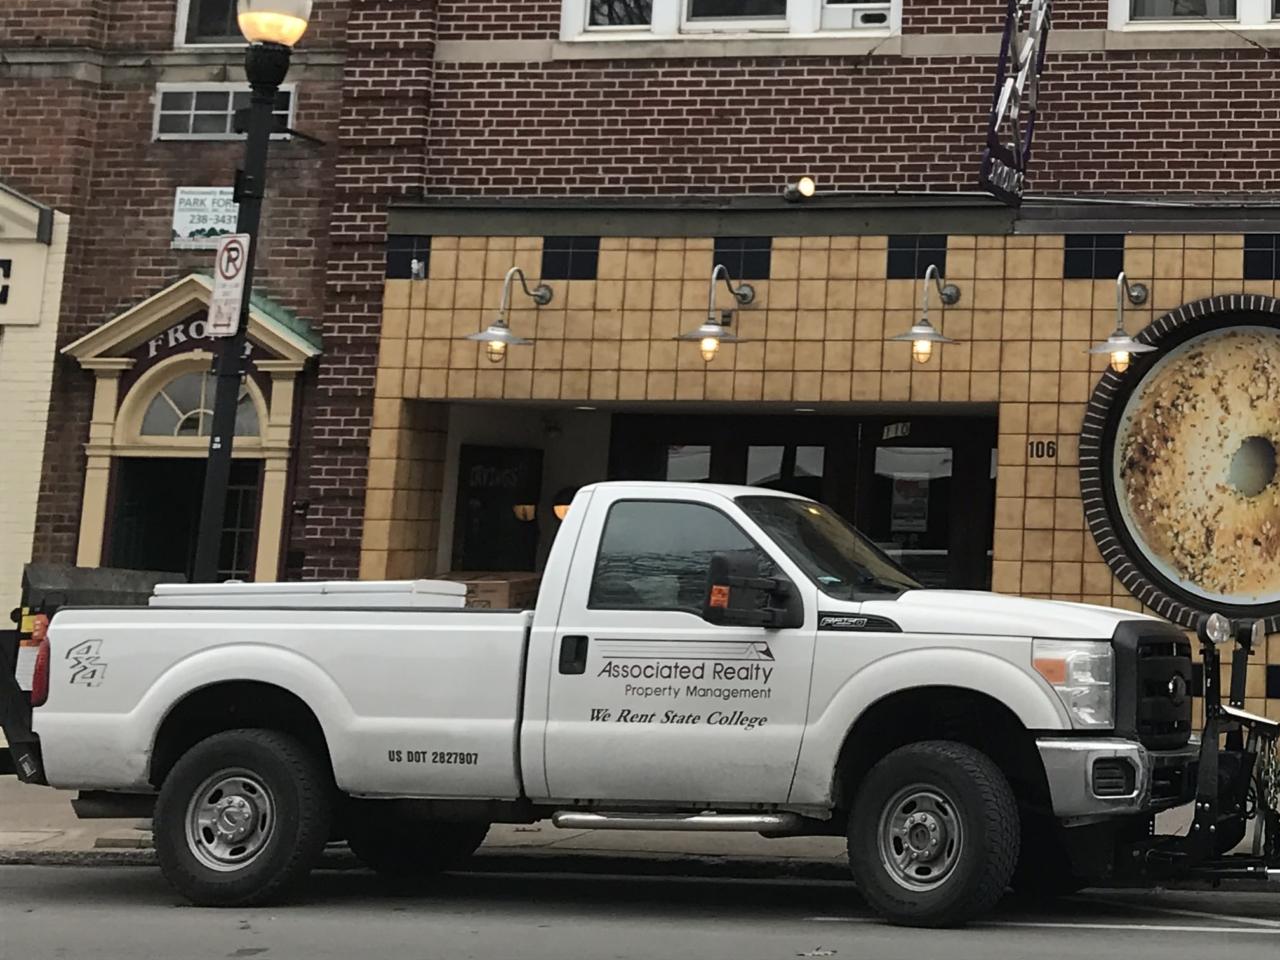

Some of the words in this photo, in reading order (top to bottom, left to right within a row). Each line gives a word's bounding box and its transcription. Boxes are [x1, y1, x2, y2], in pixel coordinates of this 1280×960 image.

[178, 198, 207, 208] PARK
[189, 214, 237, 224] 238-3431
[1029, 441, 1056, 458] 106
[598, 661, 705, 680] Associated
[712, 663, 773, 685] Realty
[625, 684, 680, 698] Property
[686, 685, 771, 700] Management
[590, 708, 611, 723] We
[616, 709, 656, 724] Rent
[660, 710, 700, 725] State
[706, 711, 768, 731] College
[388, 750, 402, 762] US
[407, 751, 427, 763] DOT
[432, 751, 478, 765] 2827907
